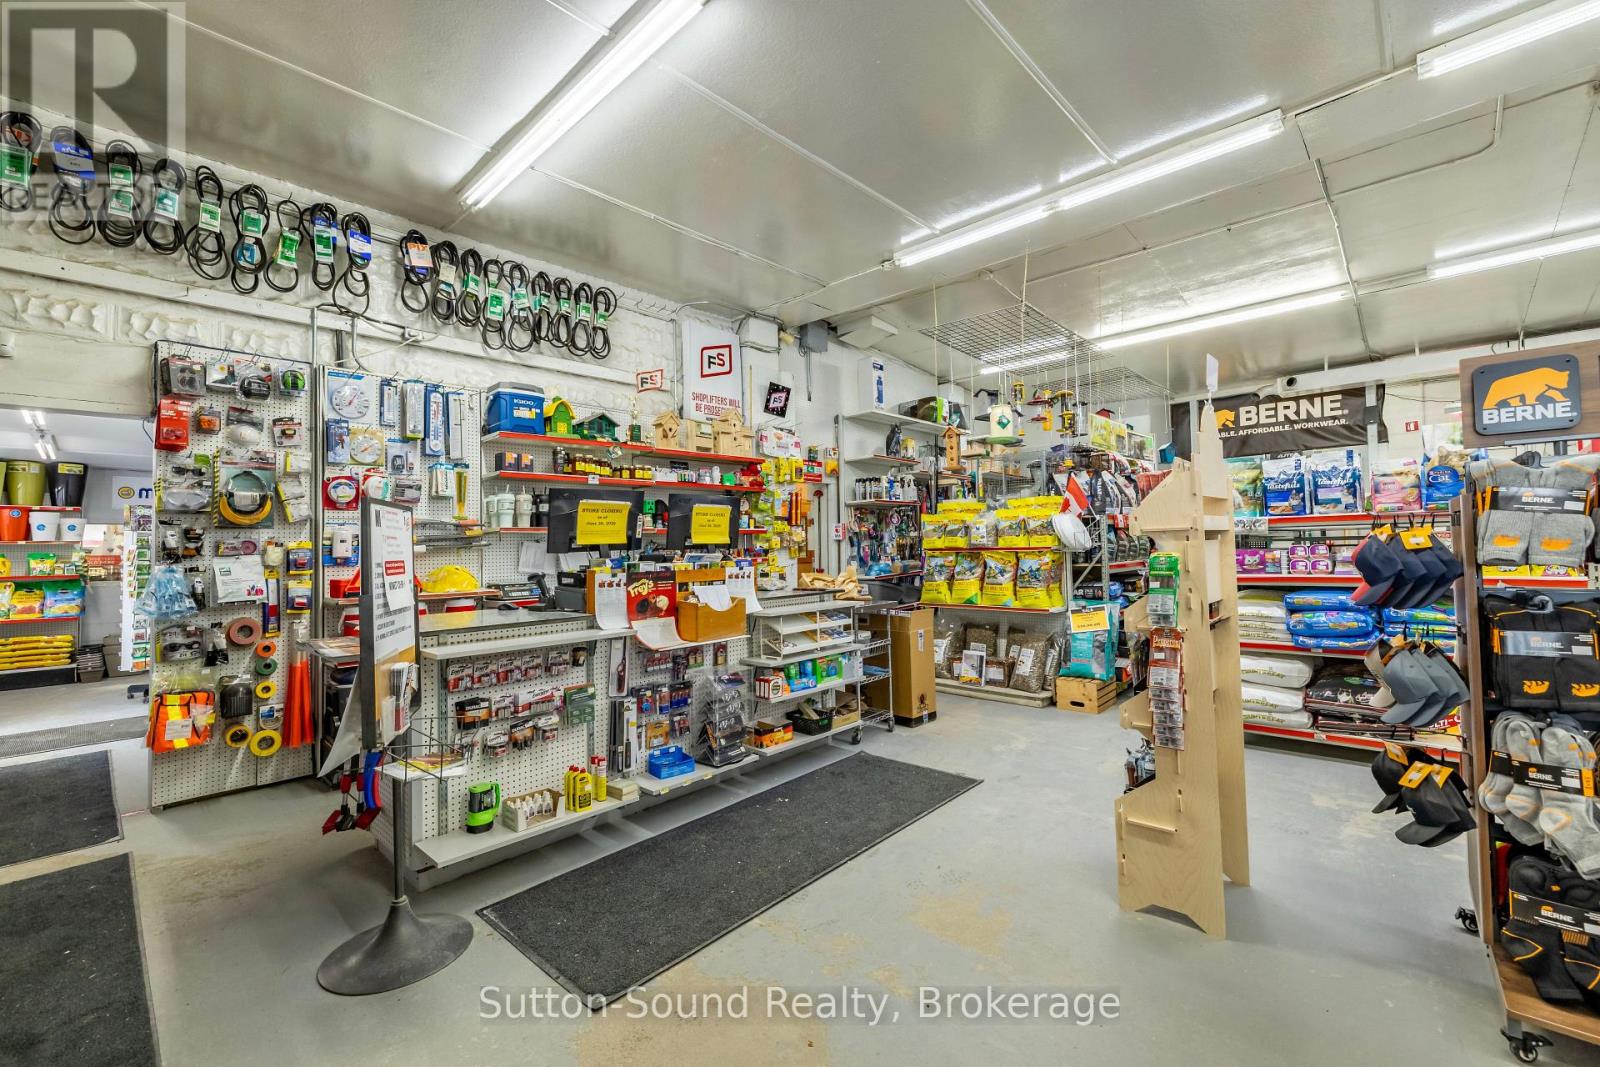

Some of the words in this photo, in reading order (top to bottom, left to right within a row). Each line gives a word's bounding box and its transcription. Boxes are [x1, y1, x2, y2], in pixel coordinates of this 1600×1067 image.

[707, 352, 726, 369] FS
[691, 391, 728, 406] SHOPLIFTERS
[728, 398, 741, 409] WILL
[695, 402, 703, 413] BE
[1238, 424, 1293, 436] AFFORDABLE.
[1293, 418, 1349, 430] WORKWEAR.
